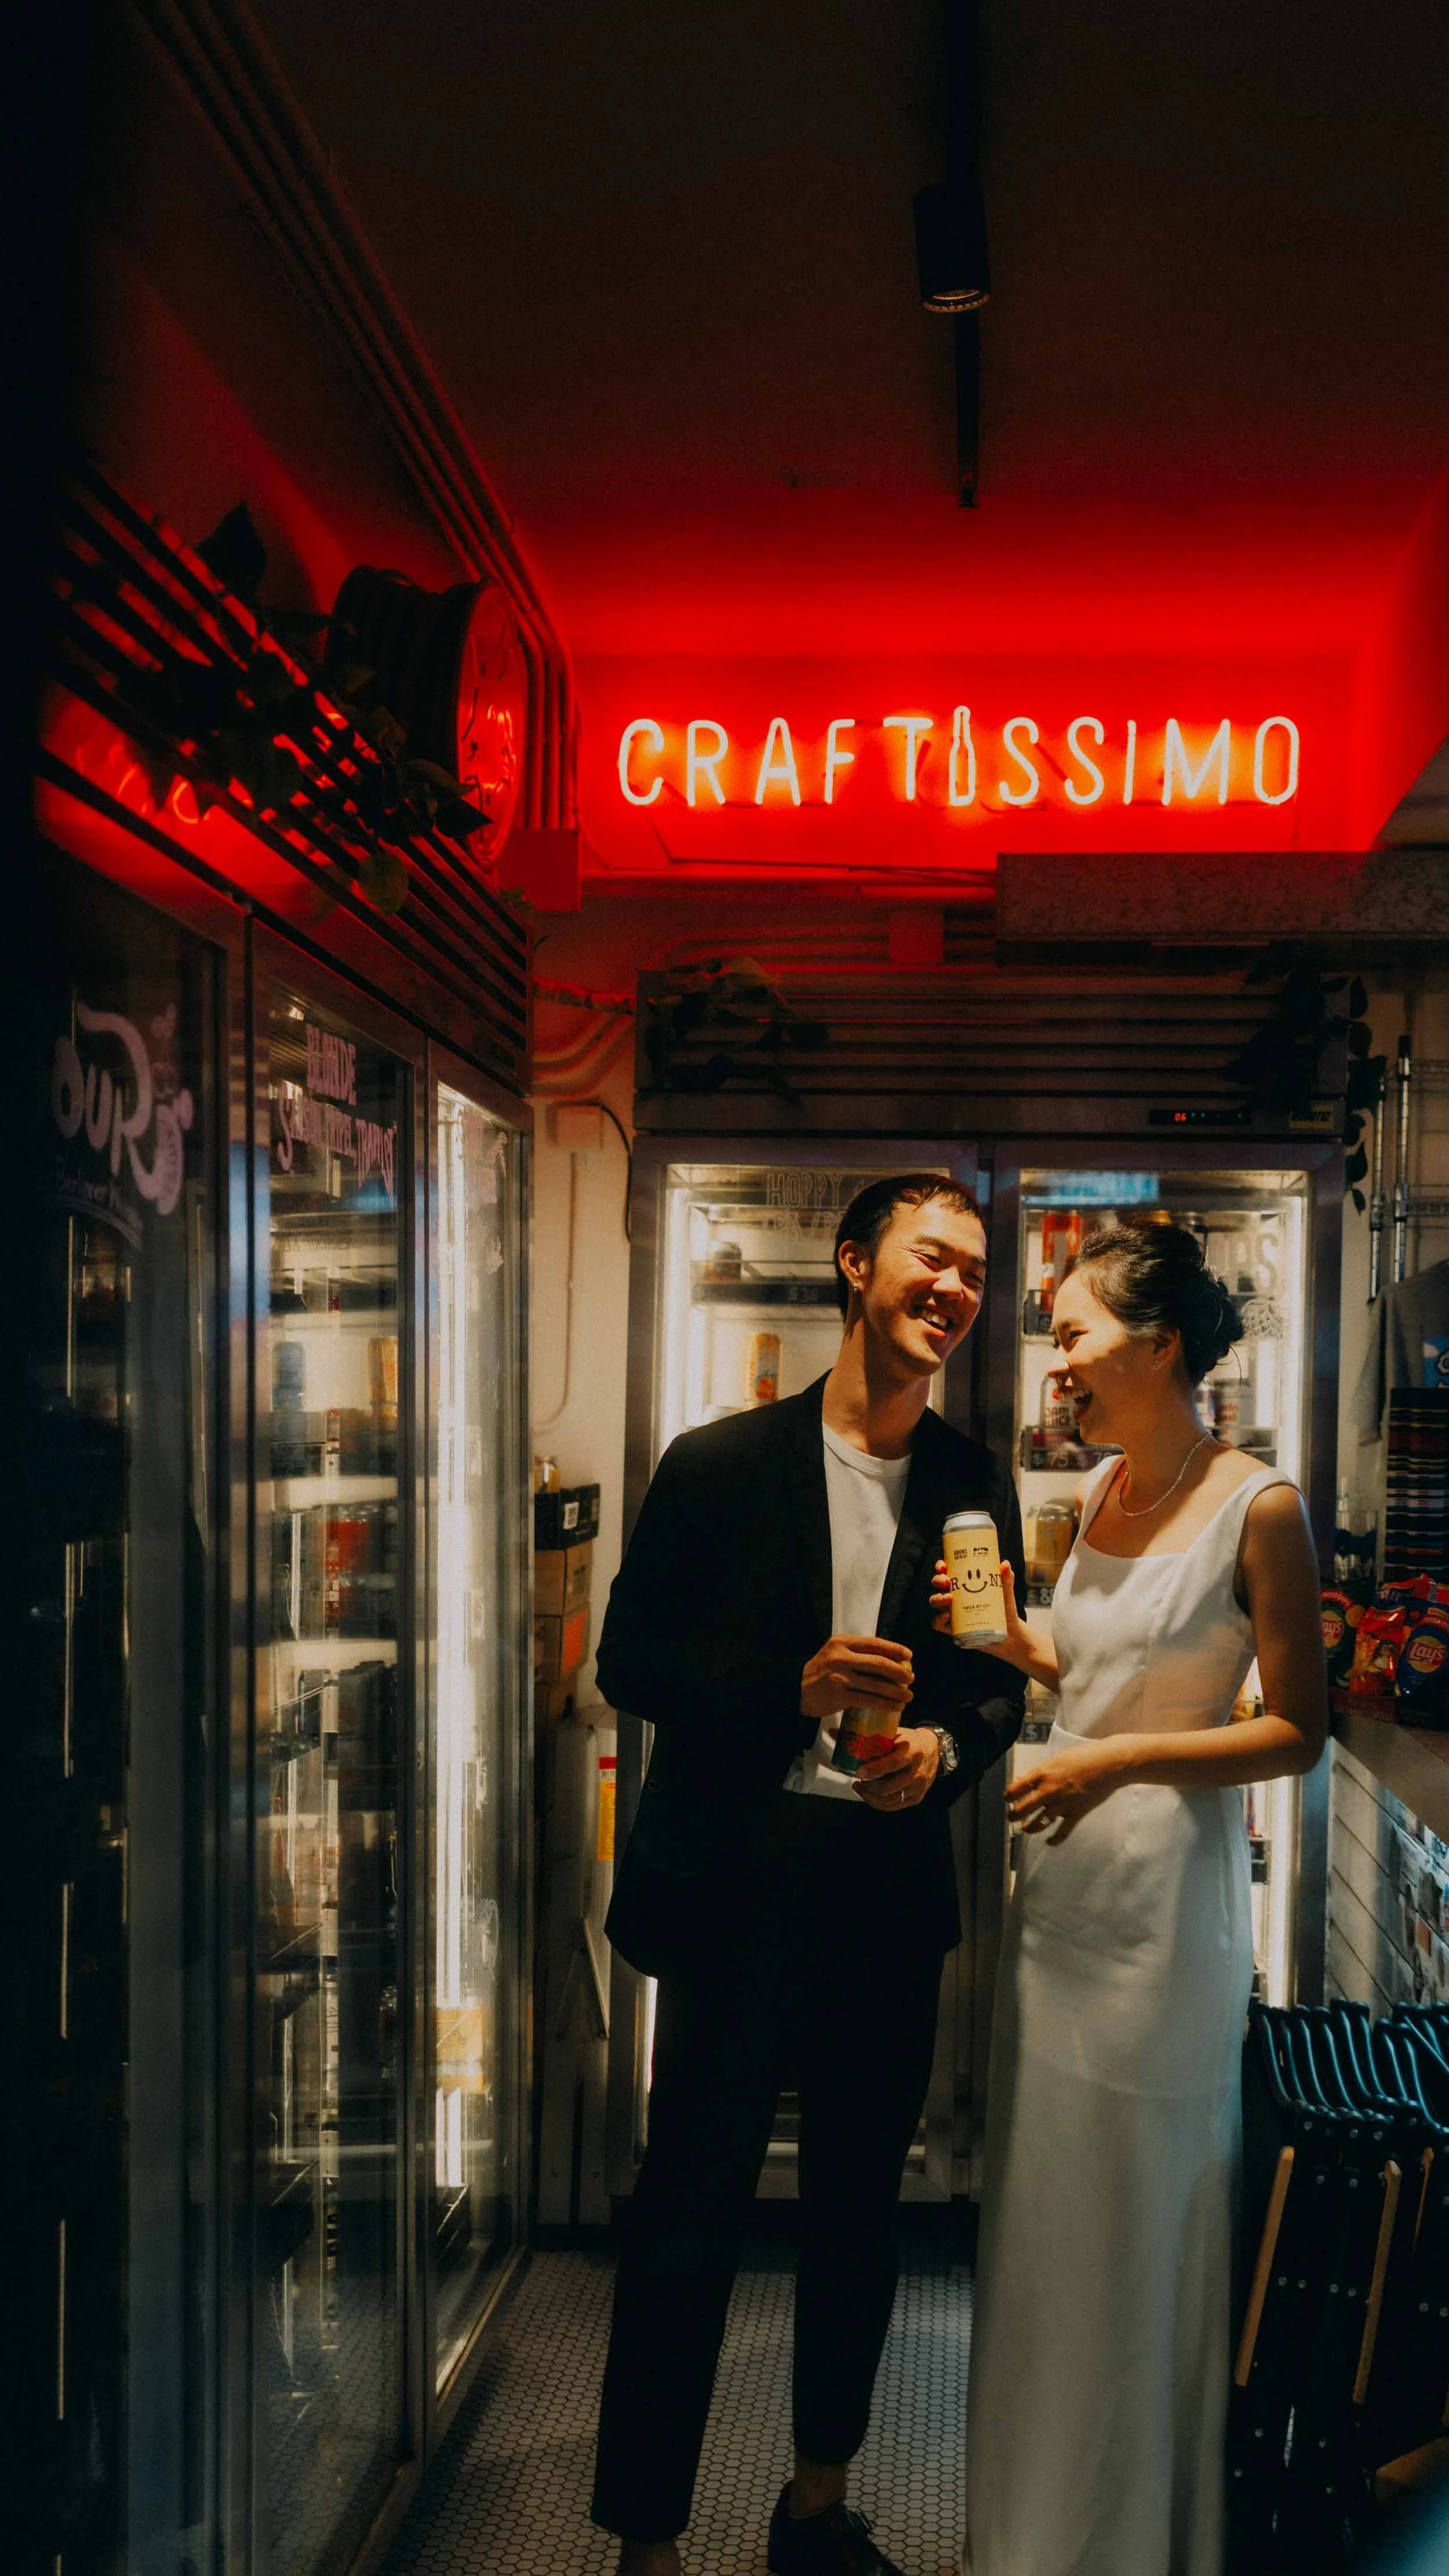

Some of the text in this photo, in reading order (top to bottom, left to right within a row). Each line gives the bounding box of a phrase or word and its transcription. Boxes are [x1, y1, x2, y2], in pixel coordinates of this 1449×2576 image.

[617, 704, 1301, 806] CRAFTISSIMO
[306, 1023, 357, 1107] BLONDE
[766, 1173, 844, 1209] HOPPY
